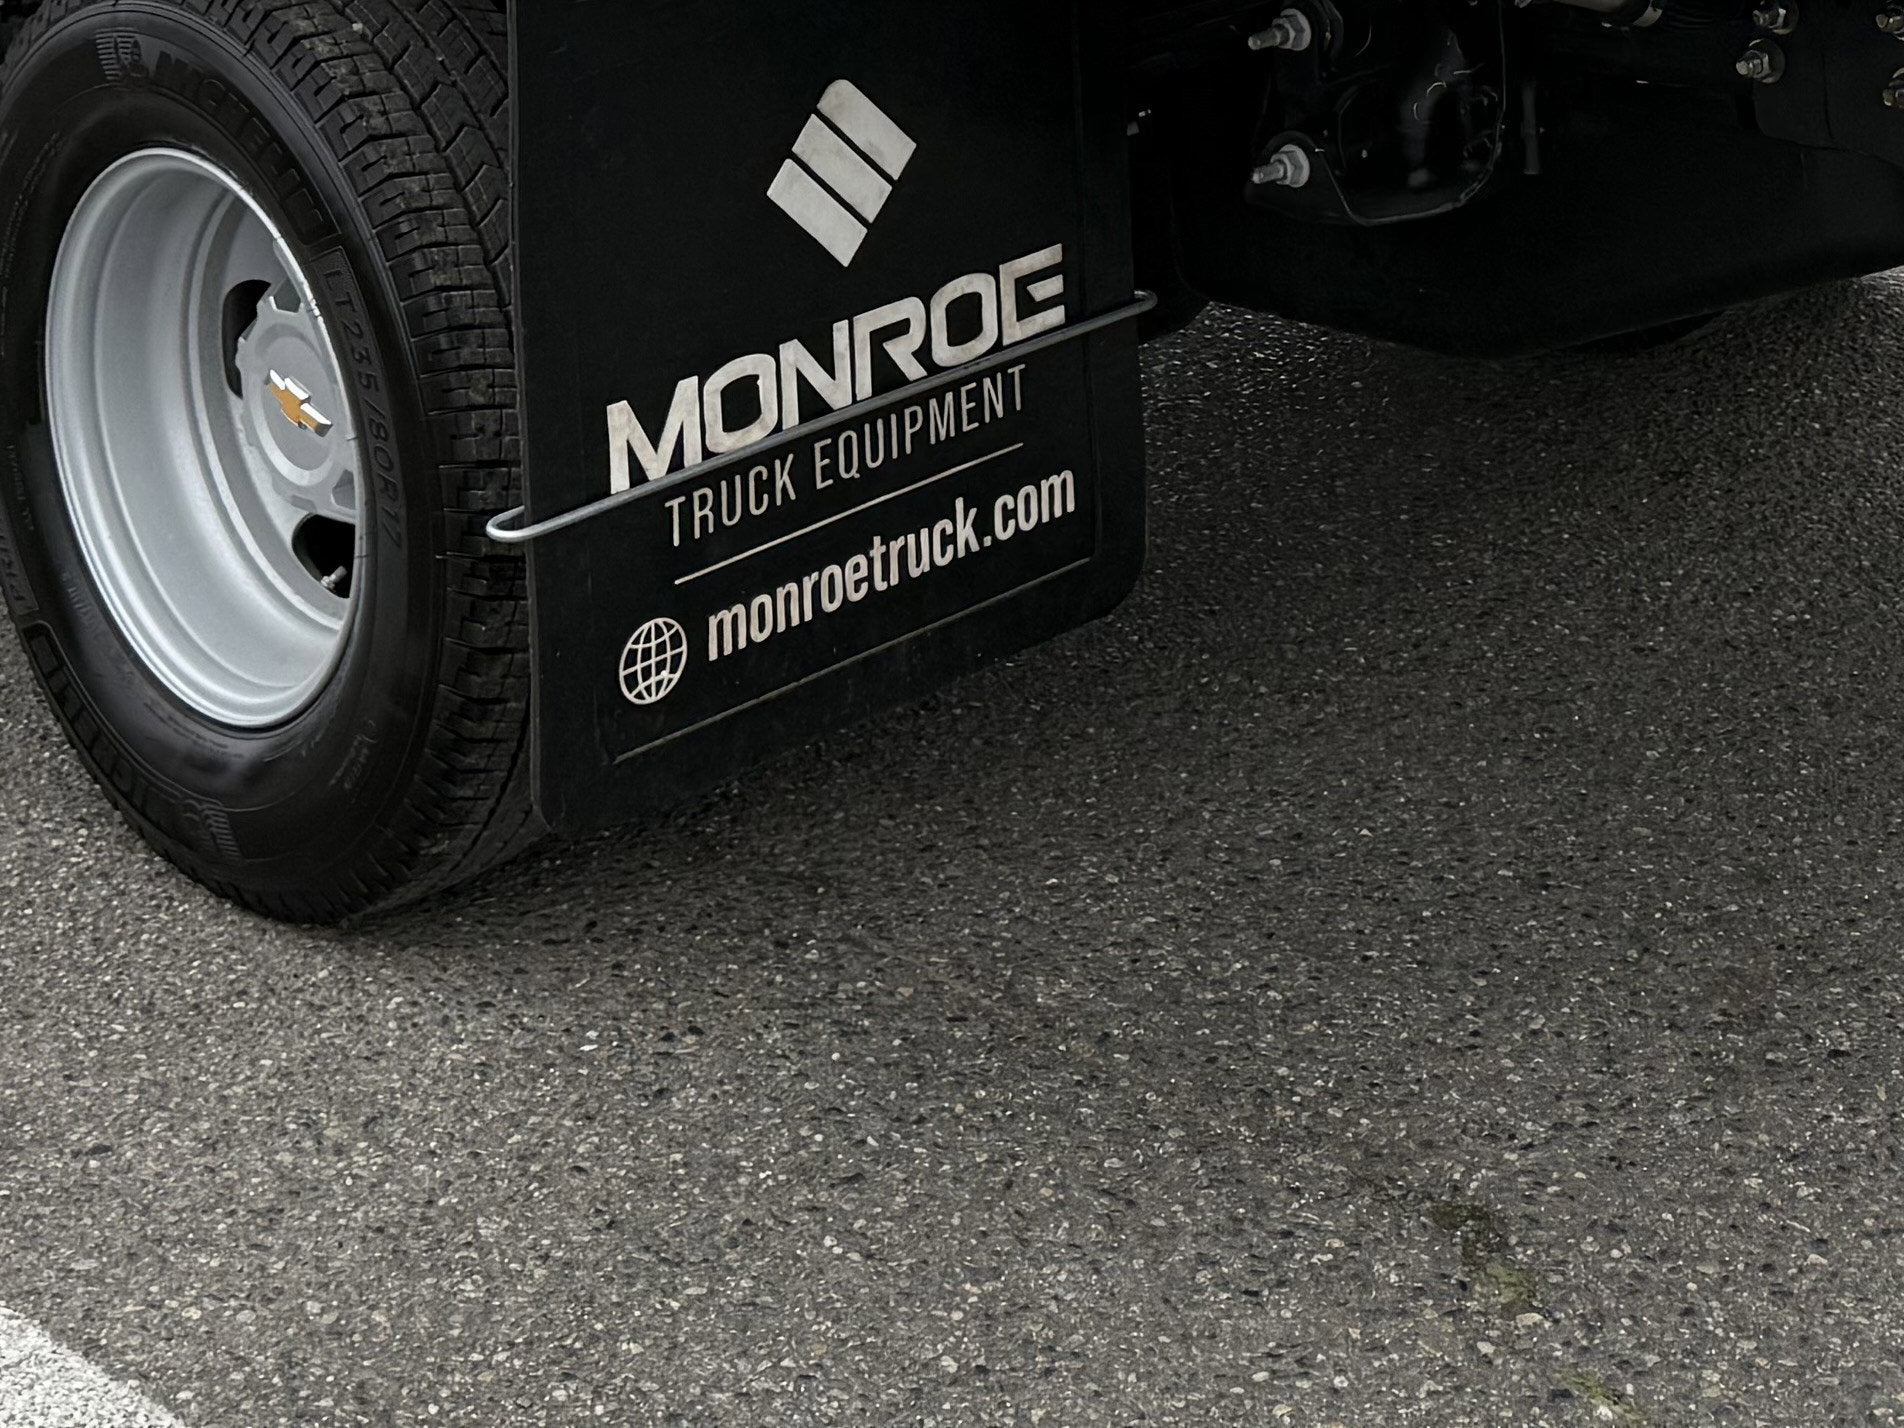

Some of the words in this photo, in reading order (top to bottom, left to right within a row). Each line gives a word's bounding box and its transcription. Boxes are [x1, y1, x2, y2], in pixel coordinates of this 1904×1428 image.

[607, 243, 1065, 494] MONROE
[665, 454, 796, 547] TRUCK
[814, 364, 1026, 490] EQUIPMENT
[708, 469, 1075, 661] monroetruck.com
